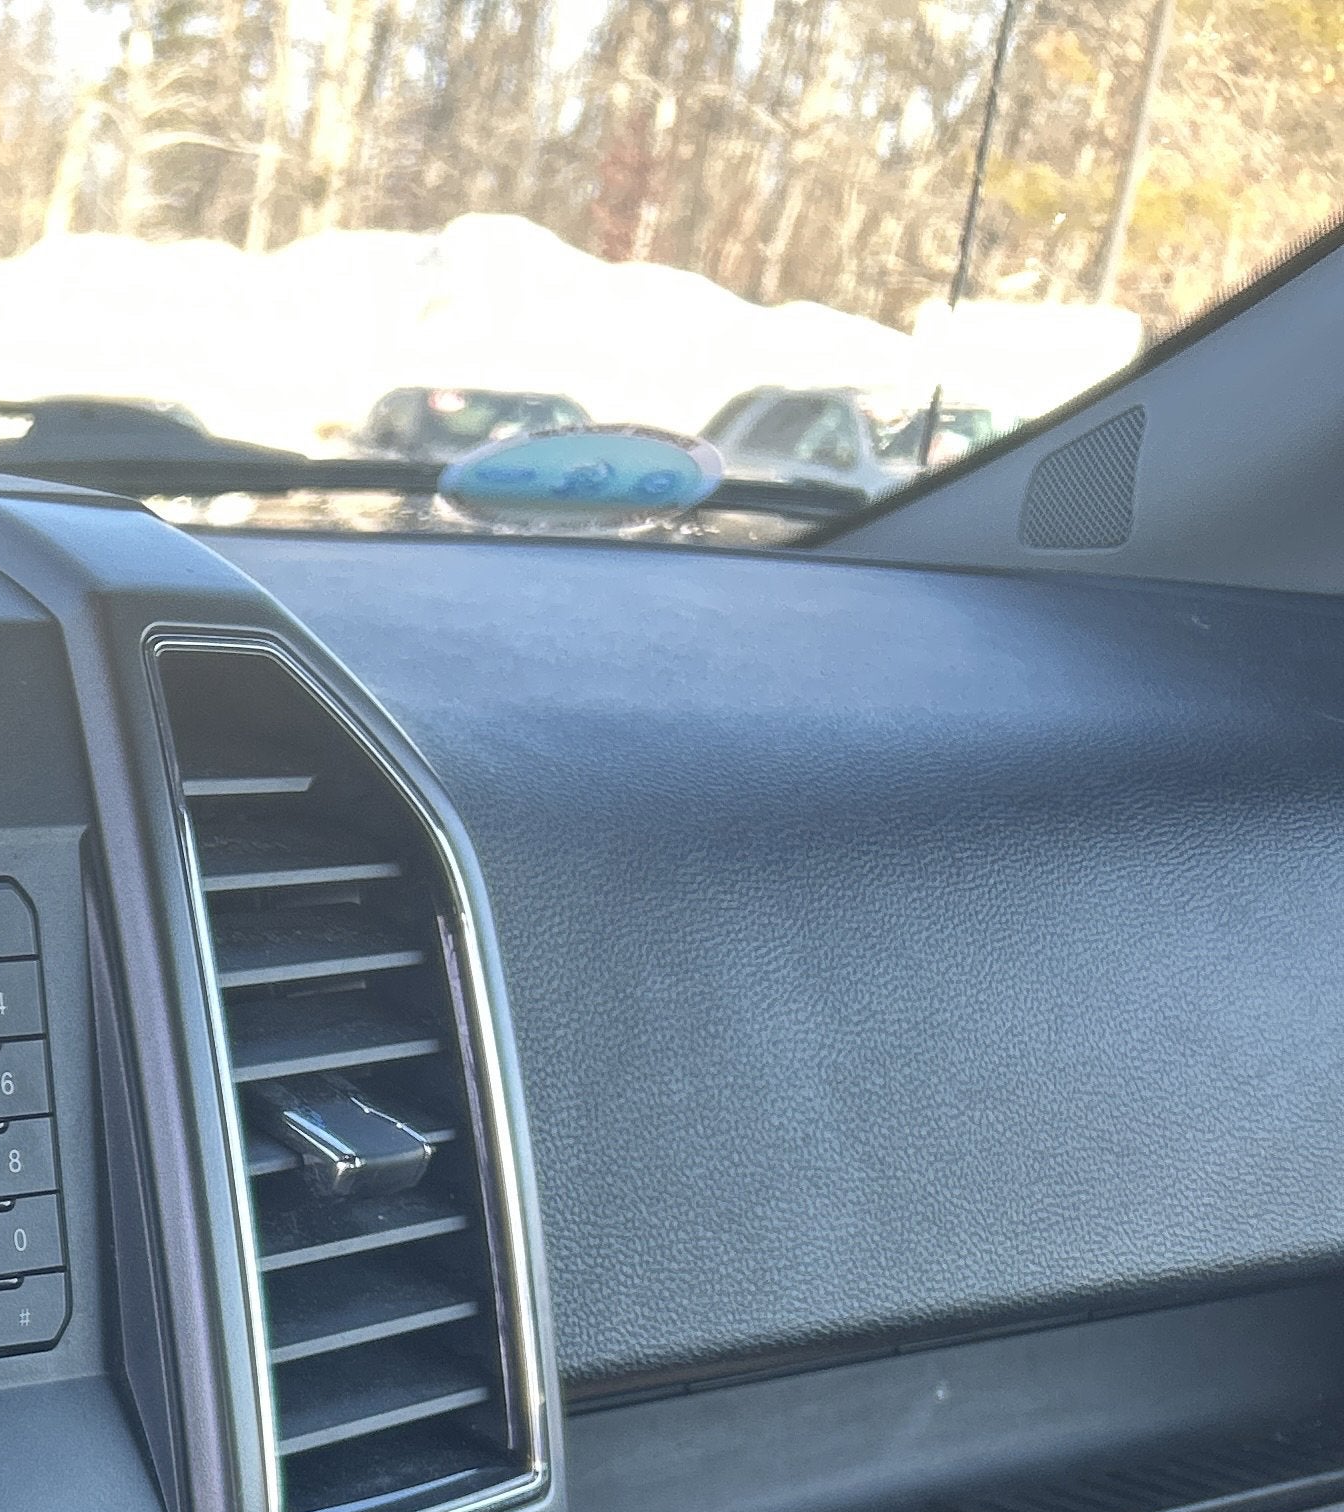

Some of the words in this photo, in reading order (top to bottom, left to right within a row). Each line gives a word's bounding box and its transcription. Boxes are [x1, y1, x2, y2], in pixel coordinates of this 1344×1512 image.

[0, 1071, 15, 1095] 6
[7, 1149, 23, 1174] 8
[13, 1228, 29, 1253] 0
